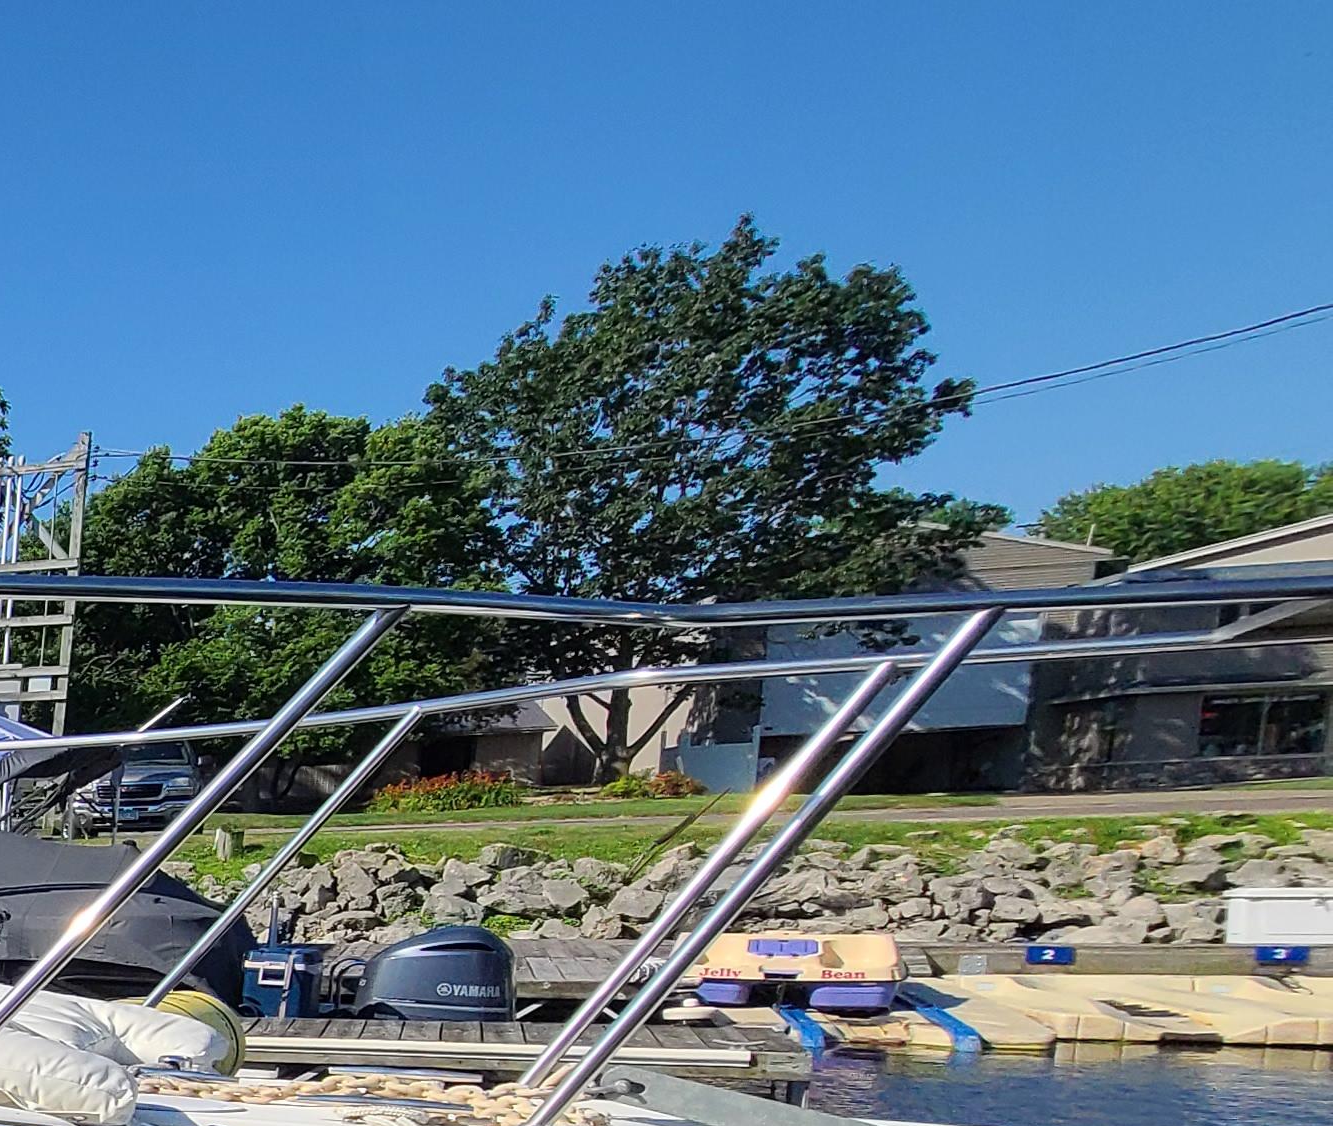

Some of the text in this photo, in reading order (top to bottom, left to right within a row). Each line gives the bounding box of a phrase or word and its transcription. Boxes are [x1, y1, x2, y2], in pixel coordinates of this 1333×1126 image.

[1041, 949, 1056, 960] 2
[699, 967, 866, 979] Jelly Bean
[453, 984, 501, 998] YAMAHA
